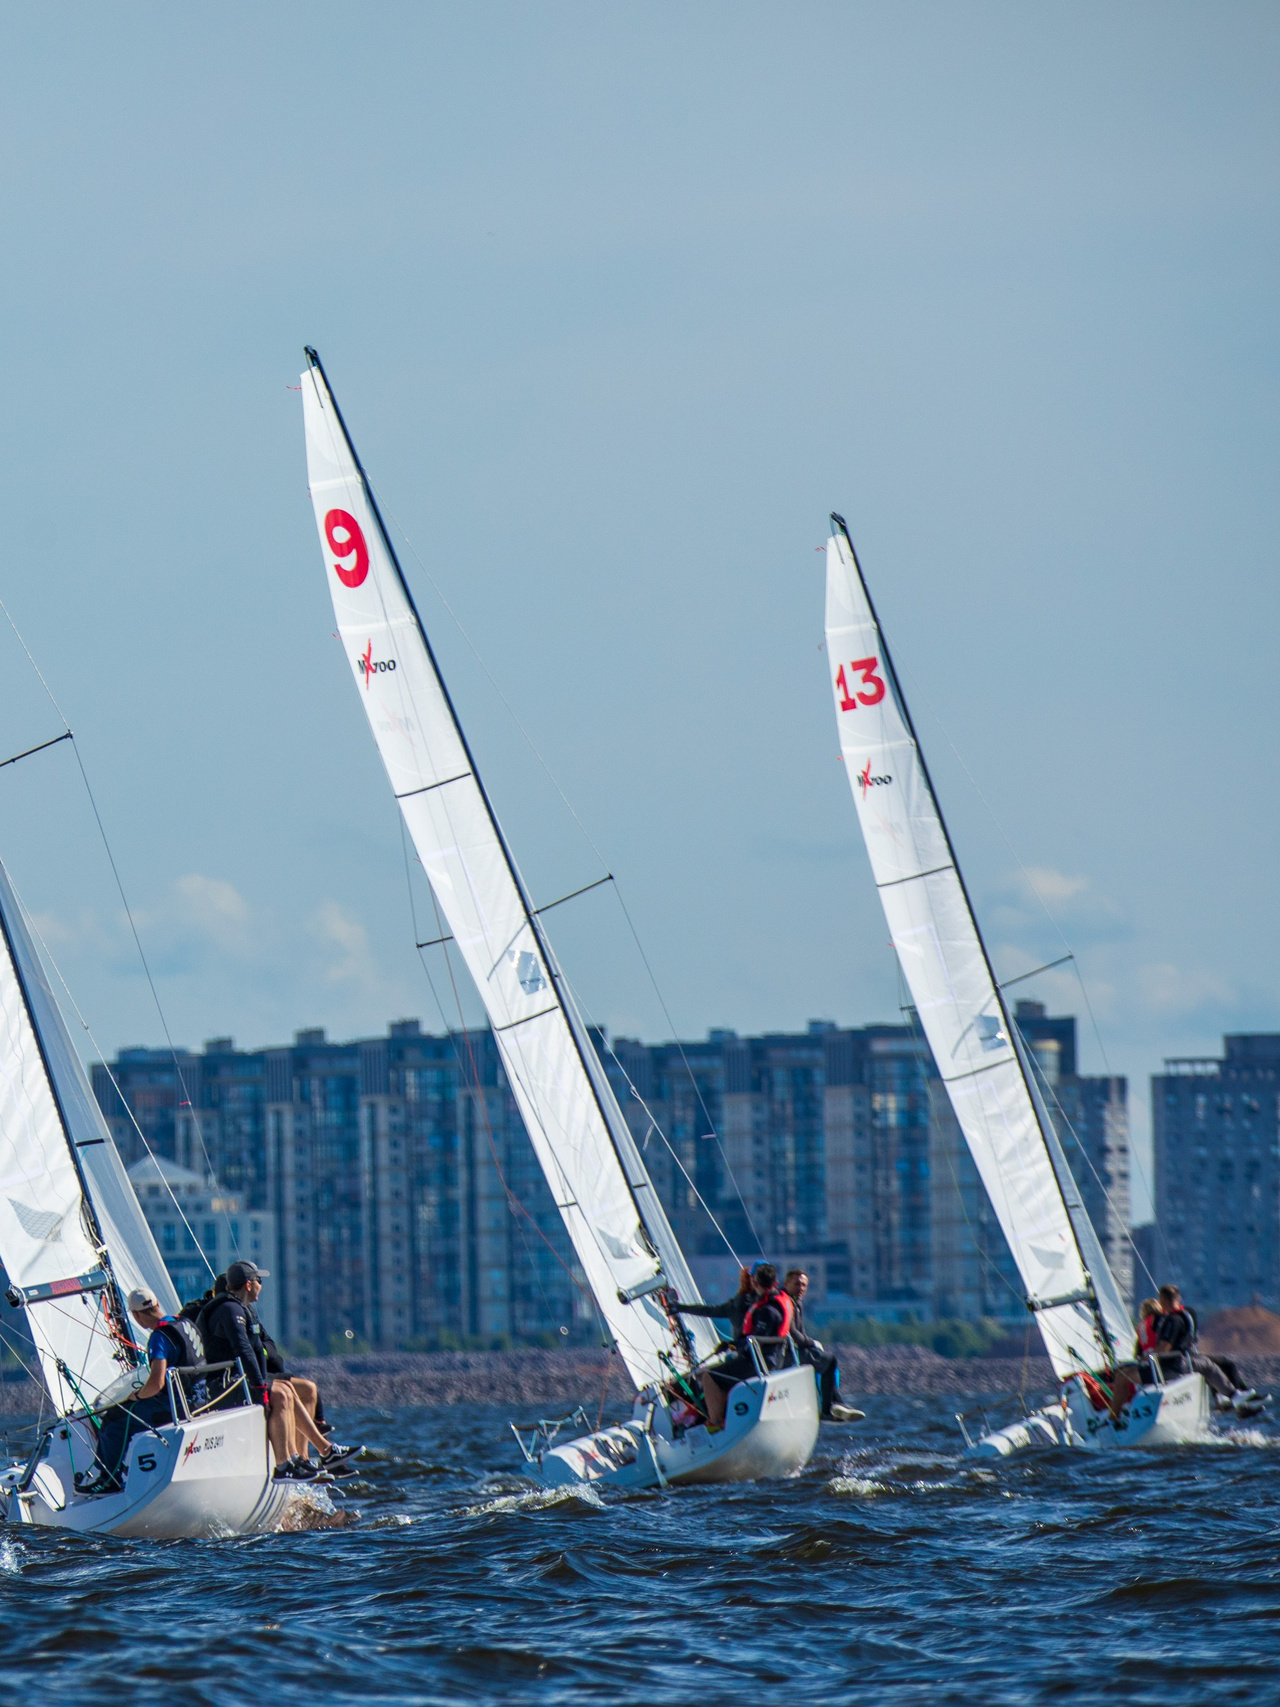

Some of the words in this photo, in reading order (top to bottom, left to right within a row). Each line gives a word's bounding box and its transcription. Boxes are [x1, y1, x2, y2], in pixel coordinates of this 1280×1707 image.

[324, 508, 370, 589] 9
[835, 656, 887, 712] 13
[734, 1402, 749, 1416] 9
[137, 1453, 157, 1472] 5
